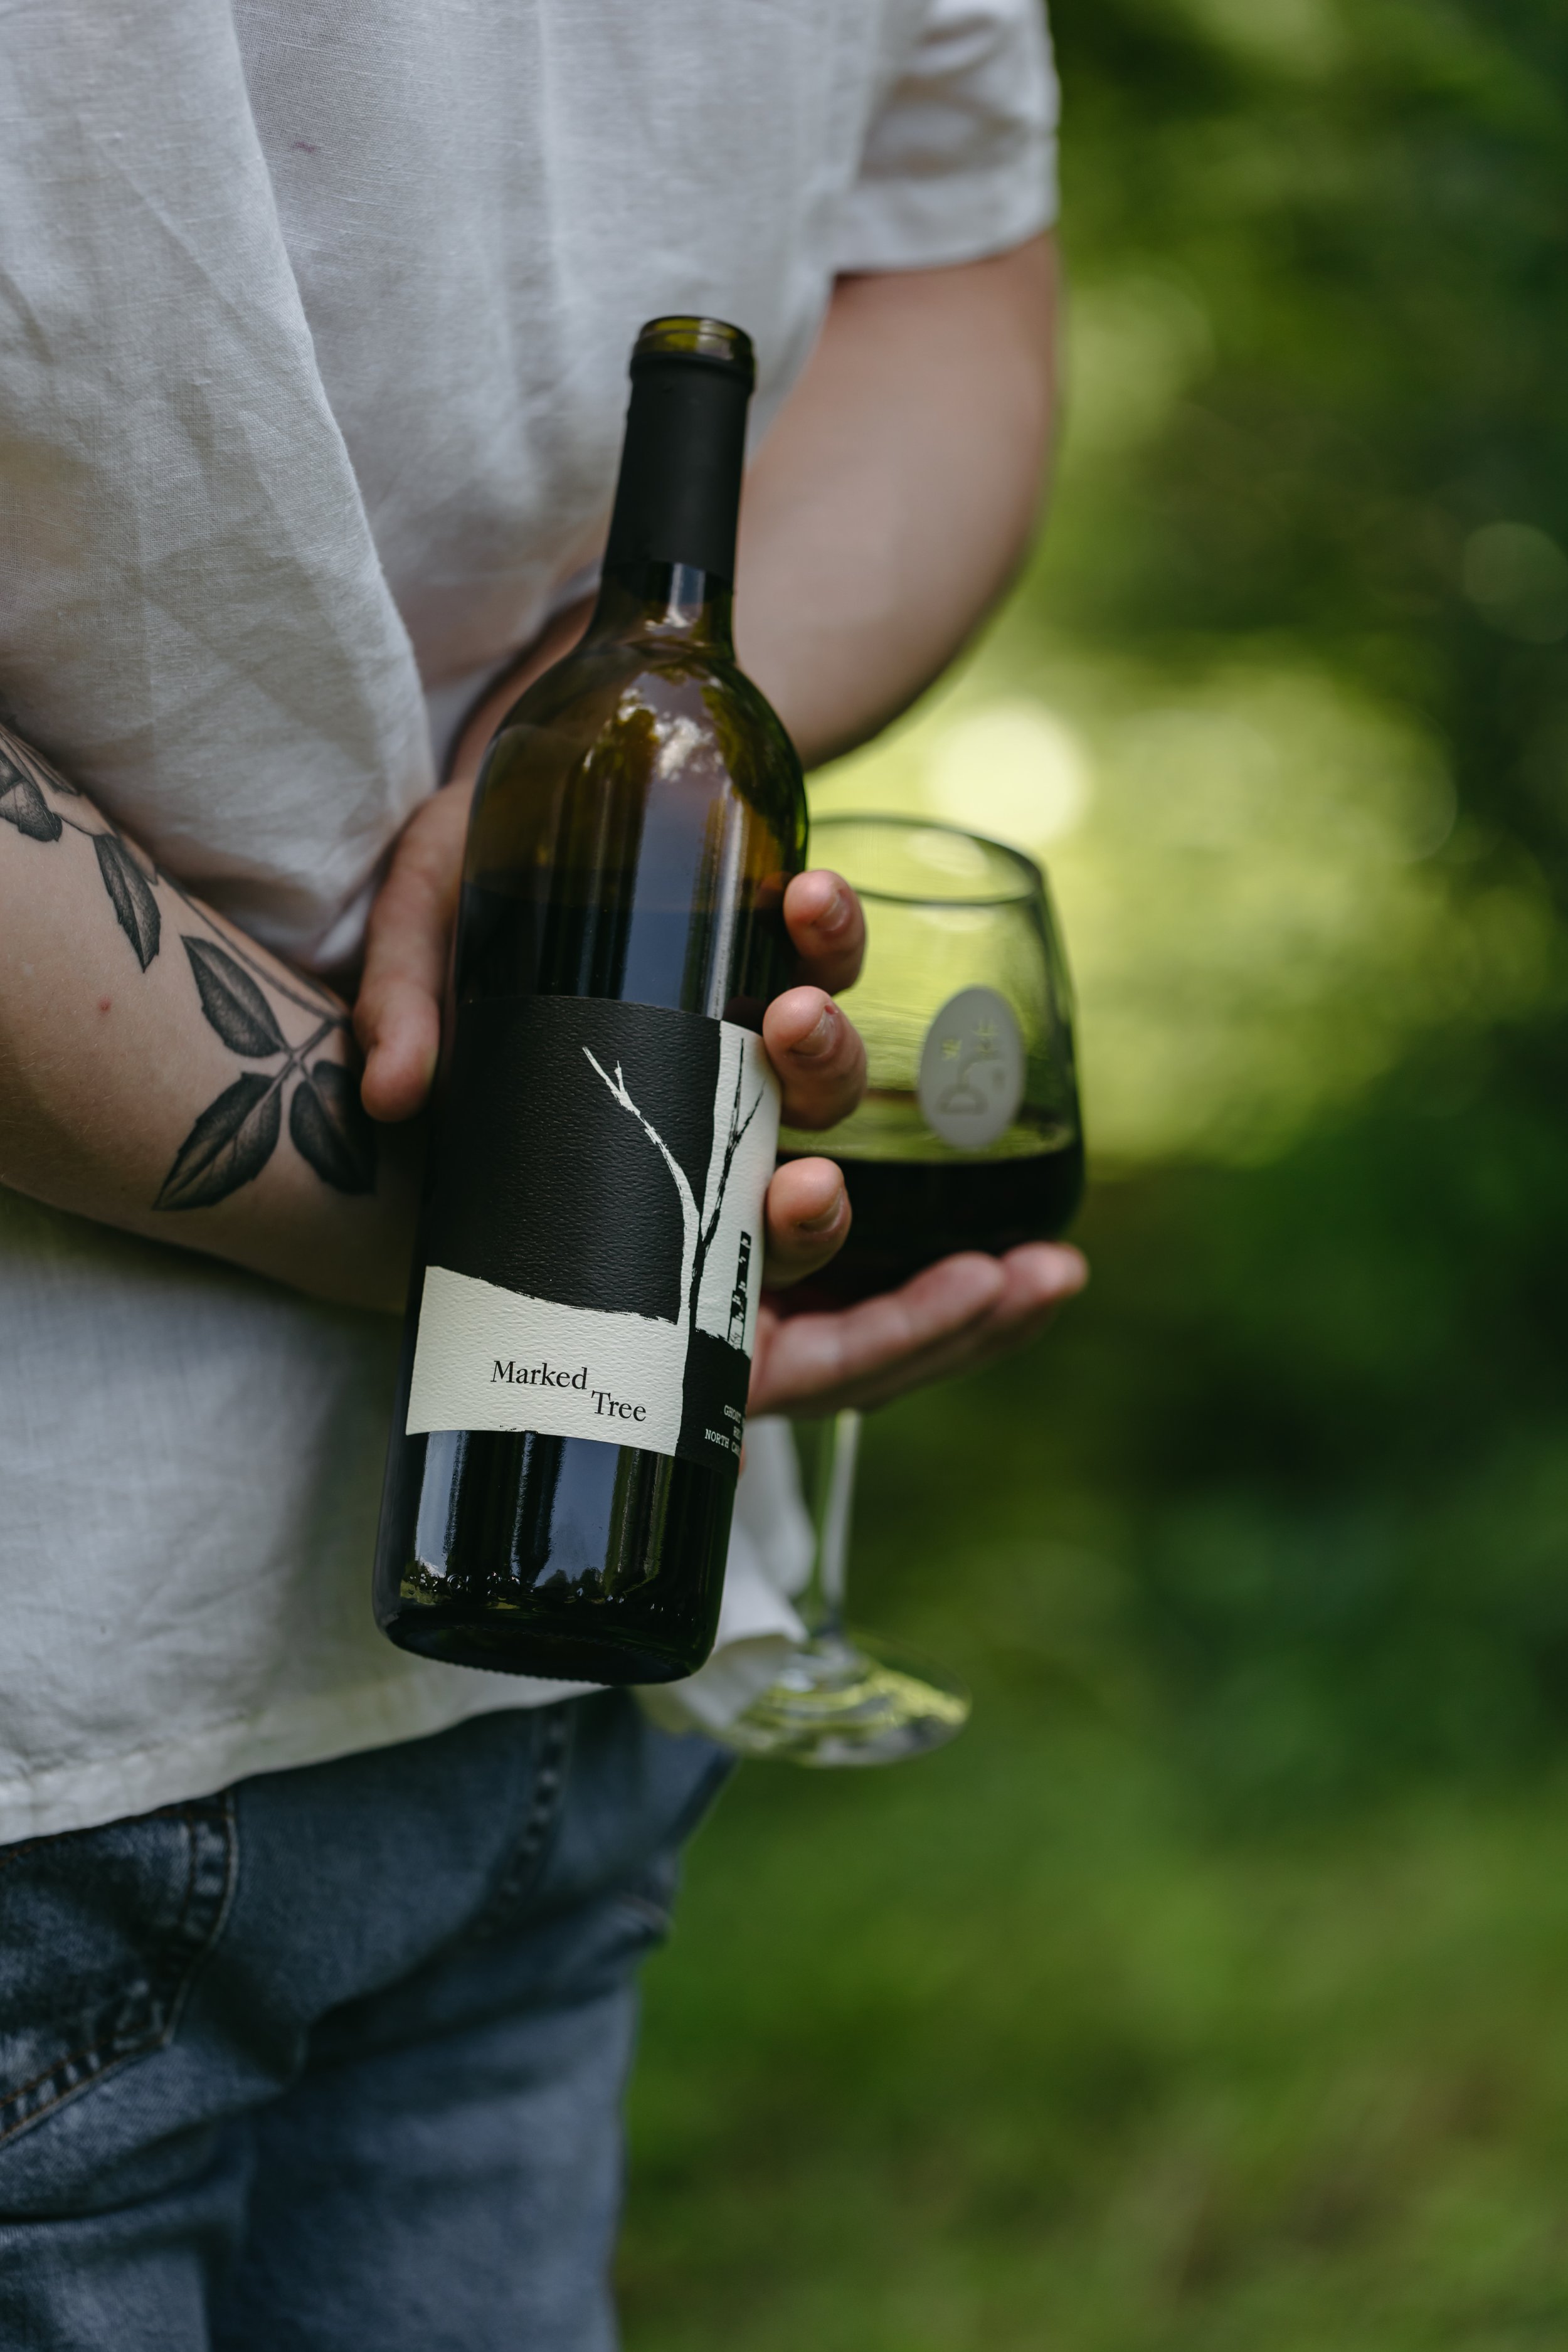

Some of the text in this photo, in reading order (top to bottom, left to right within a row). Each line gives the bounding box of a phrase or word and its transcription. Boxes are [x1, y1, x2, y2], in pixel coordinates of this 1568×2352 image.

[490, 1360, 588, 1390] Marked
[591, 1390, 646, 1422] Tree
[704, 1428, 729, 1448] NORTH
